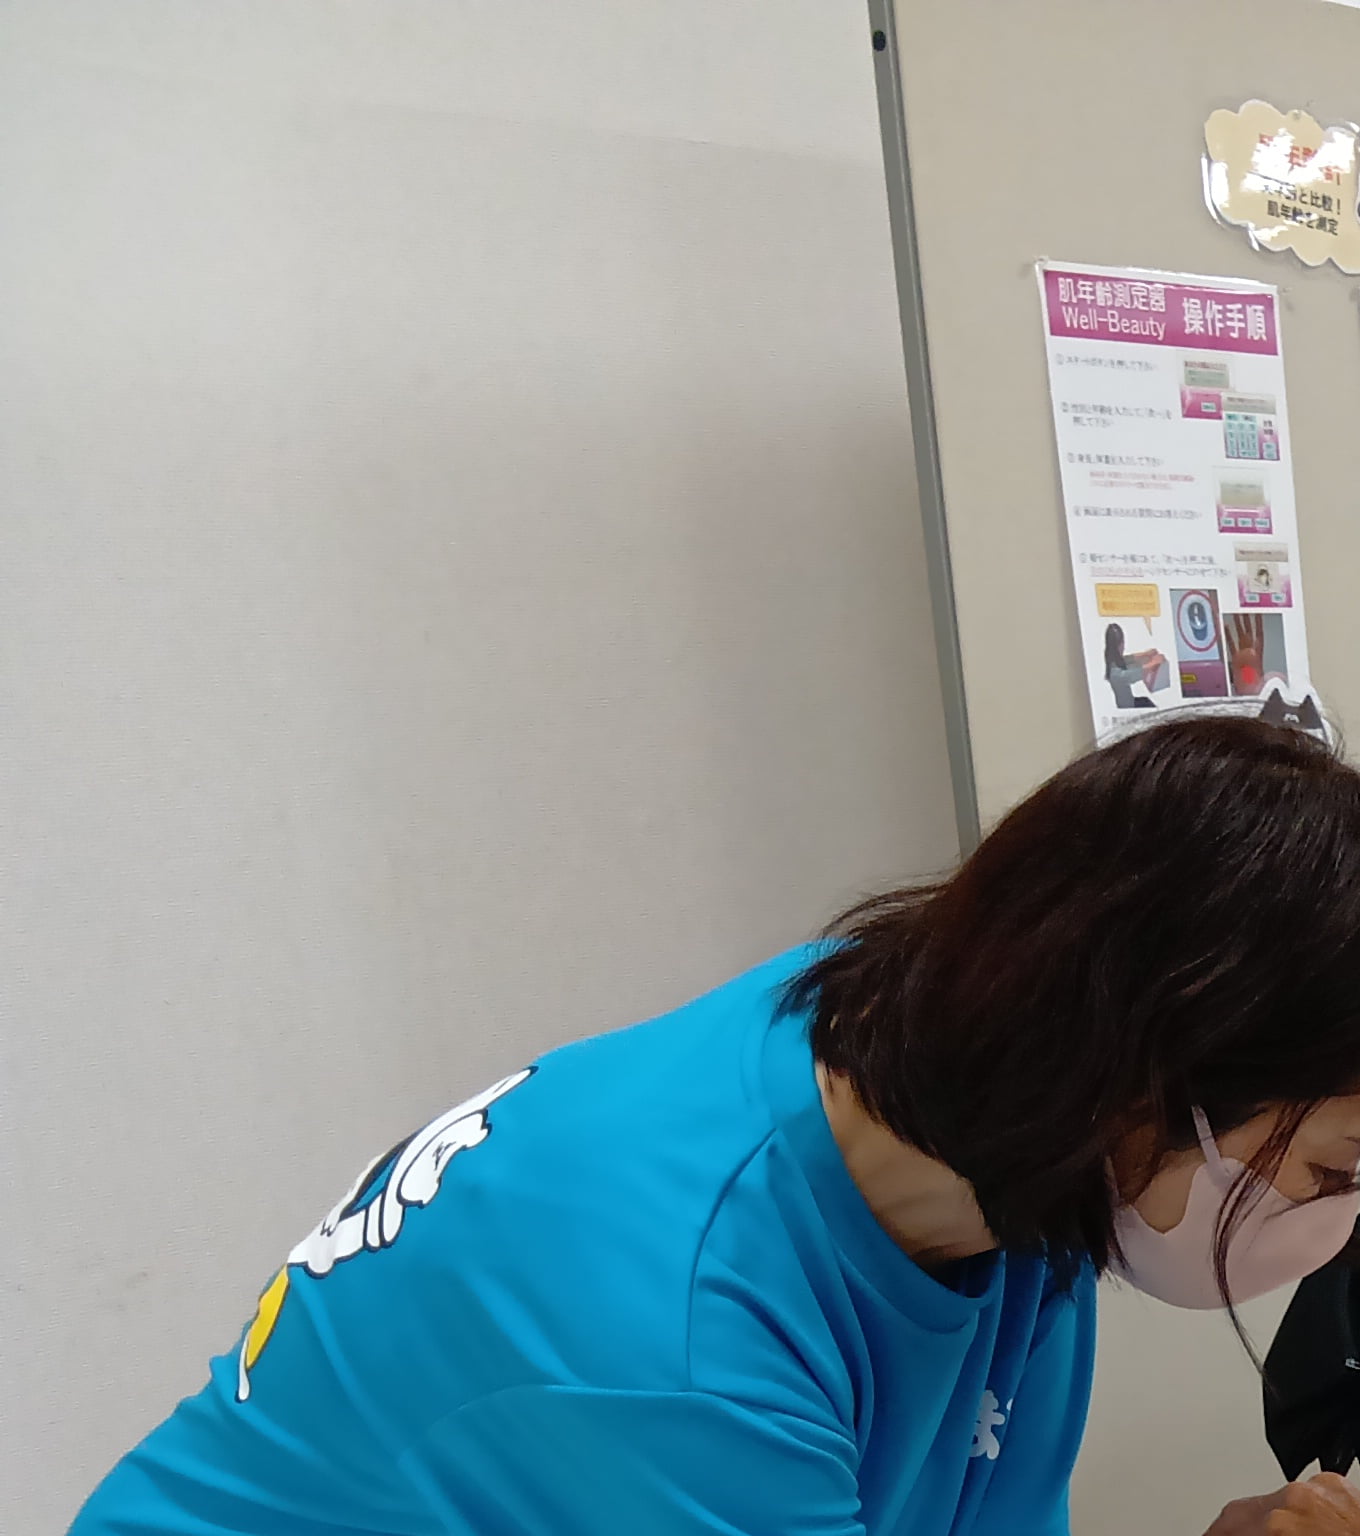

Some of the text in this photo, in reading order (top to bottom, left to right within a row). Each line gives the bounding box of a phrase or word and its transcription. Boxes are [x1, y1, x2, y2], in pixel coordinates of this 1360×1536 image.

[1058, 277, 1166, 312] 肌年齢測定器
[1062, 306, 1166, 341] Well-Beauty
[1182, 297, 1268, 341] 操作手順
